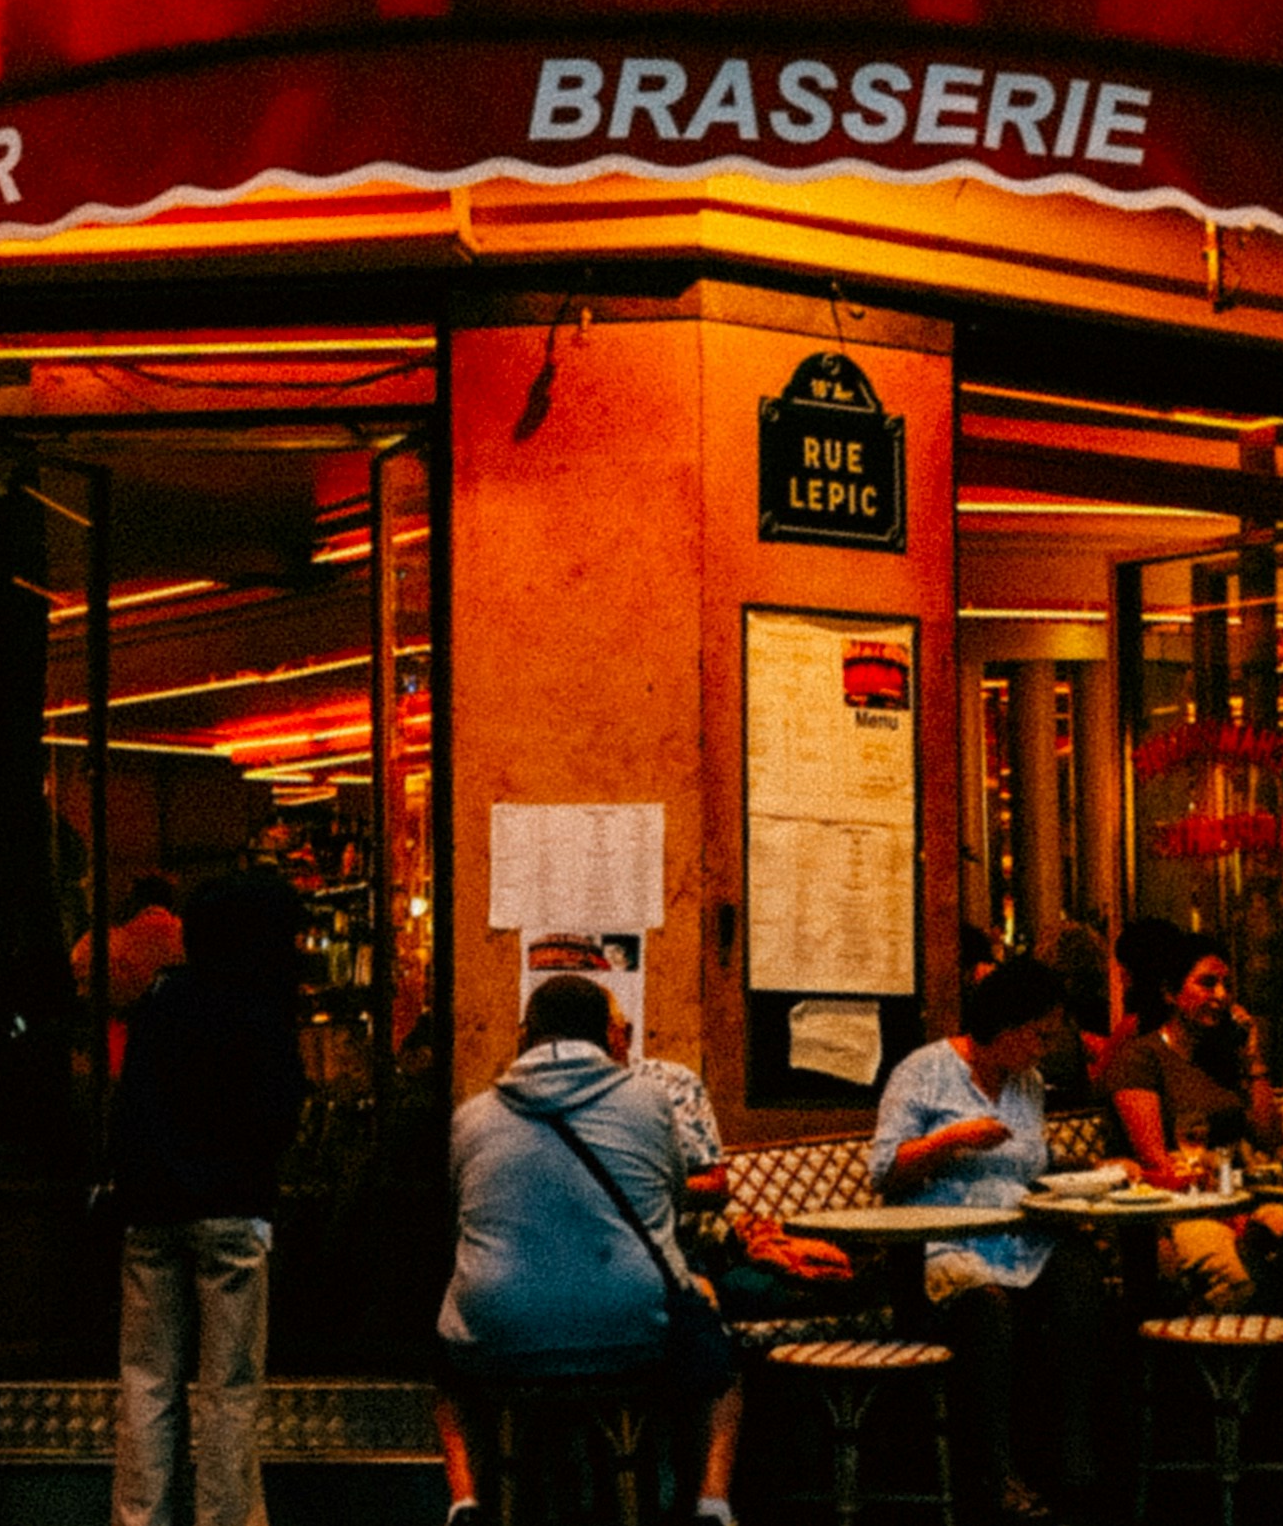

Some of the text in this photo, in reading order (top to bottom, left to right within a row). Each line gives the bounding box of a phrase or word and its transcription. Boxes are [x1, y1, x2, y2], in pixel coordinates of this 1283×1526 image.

[528, 58, 1152, 165] BRASSERIE
[803, 436, 863, 473] RUE
[789, 477, 877, 517] LEPIC
